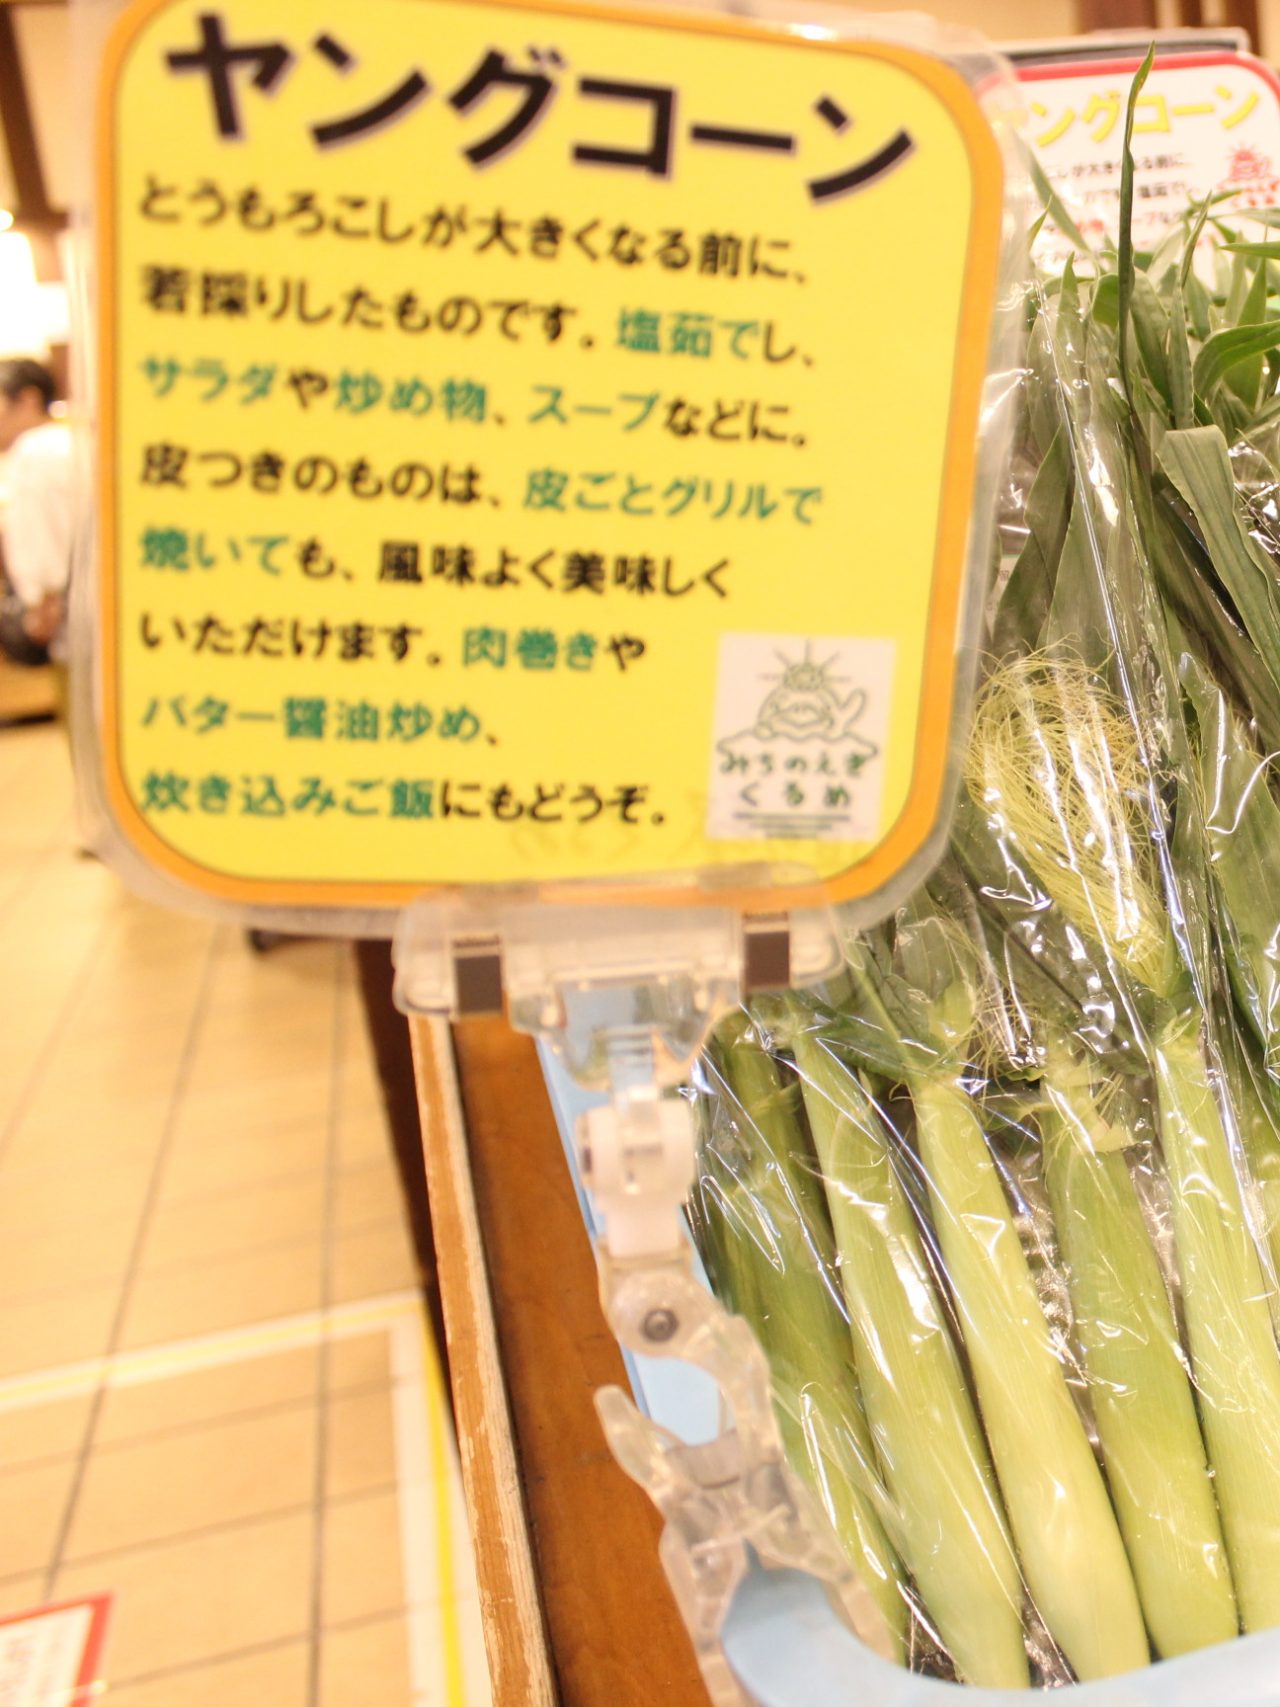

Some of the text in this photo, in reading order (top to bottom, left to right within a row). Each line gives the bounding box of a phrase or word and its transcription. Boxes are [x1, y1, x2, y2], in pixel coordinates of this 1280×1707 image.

[164, 12, 916, 205] ヤングコーン
[139, 178, 808, 283] とうもろこしが大きくなる前に、
[142, 264, 814, 367] 若採りしたものです。塩茹でし、
[141, 355, 808, 448] サラダや炒め物、スープなどに。
[140, 441, 824, 526] 皮つきのものは、皮ごとグリルで
[140, 525, 731, 599] 焼いても、風味よく美味しく
[139, 612, 648, 673] いただけます。肉巻きや
[142, 694, 500, 748] バター醤油炒め、
[140, 770, 668, 828] 炊き込みご飯にもどうぞ。
[740, 780, 851, 808] くるめ
